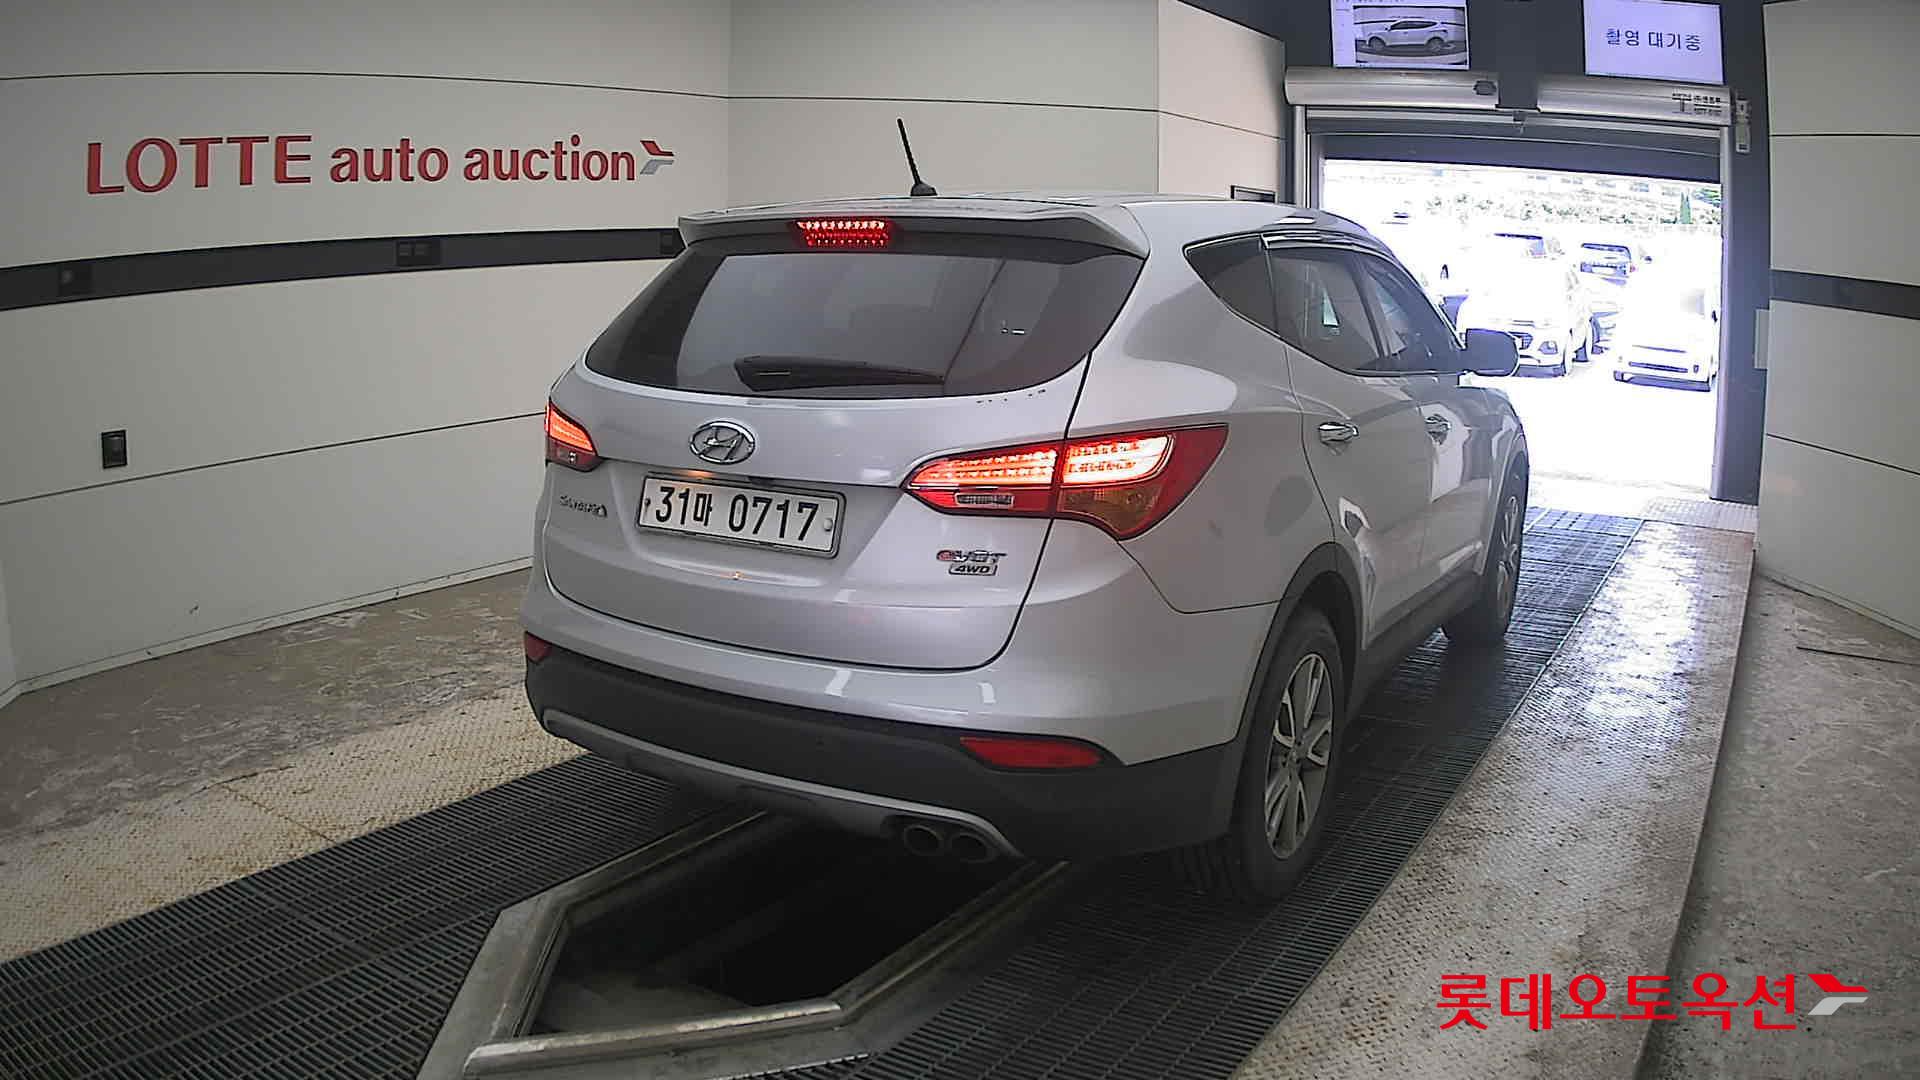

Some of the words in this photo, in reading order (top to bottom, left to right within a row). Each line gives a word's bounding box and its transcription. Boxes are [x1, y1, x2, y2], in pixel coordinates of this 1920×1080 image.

[87, 135, 312, 195] LOTTE
[330, 138, 450, 183] auto
[463, 134, 636, 182] auction
[655, 486, 713, 526] 31마
[728, 493, 820, 541] 0717
[954, 565, 990, 574] 4WD
